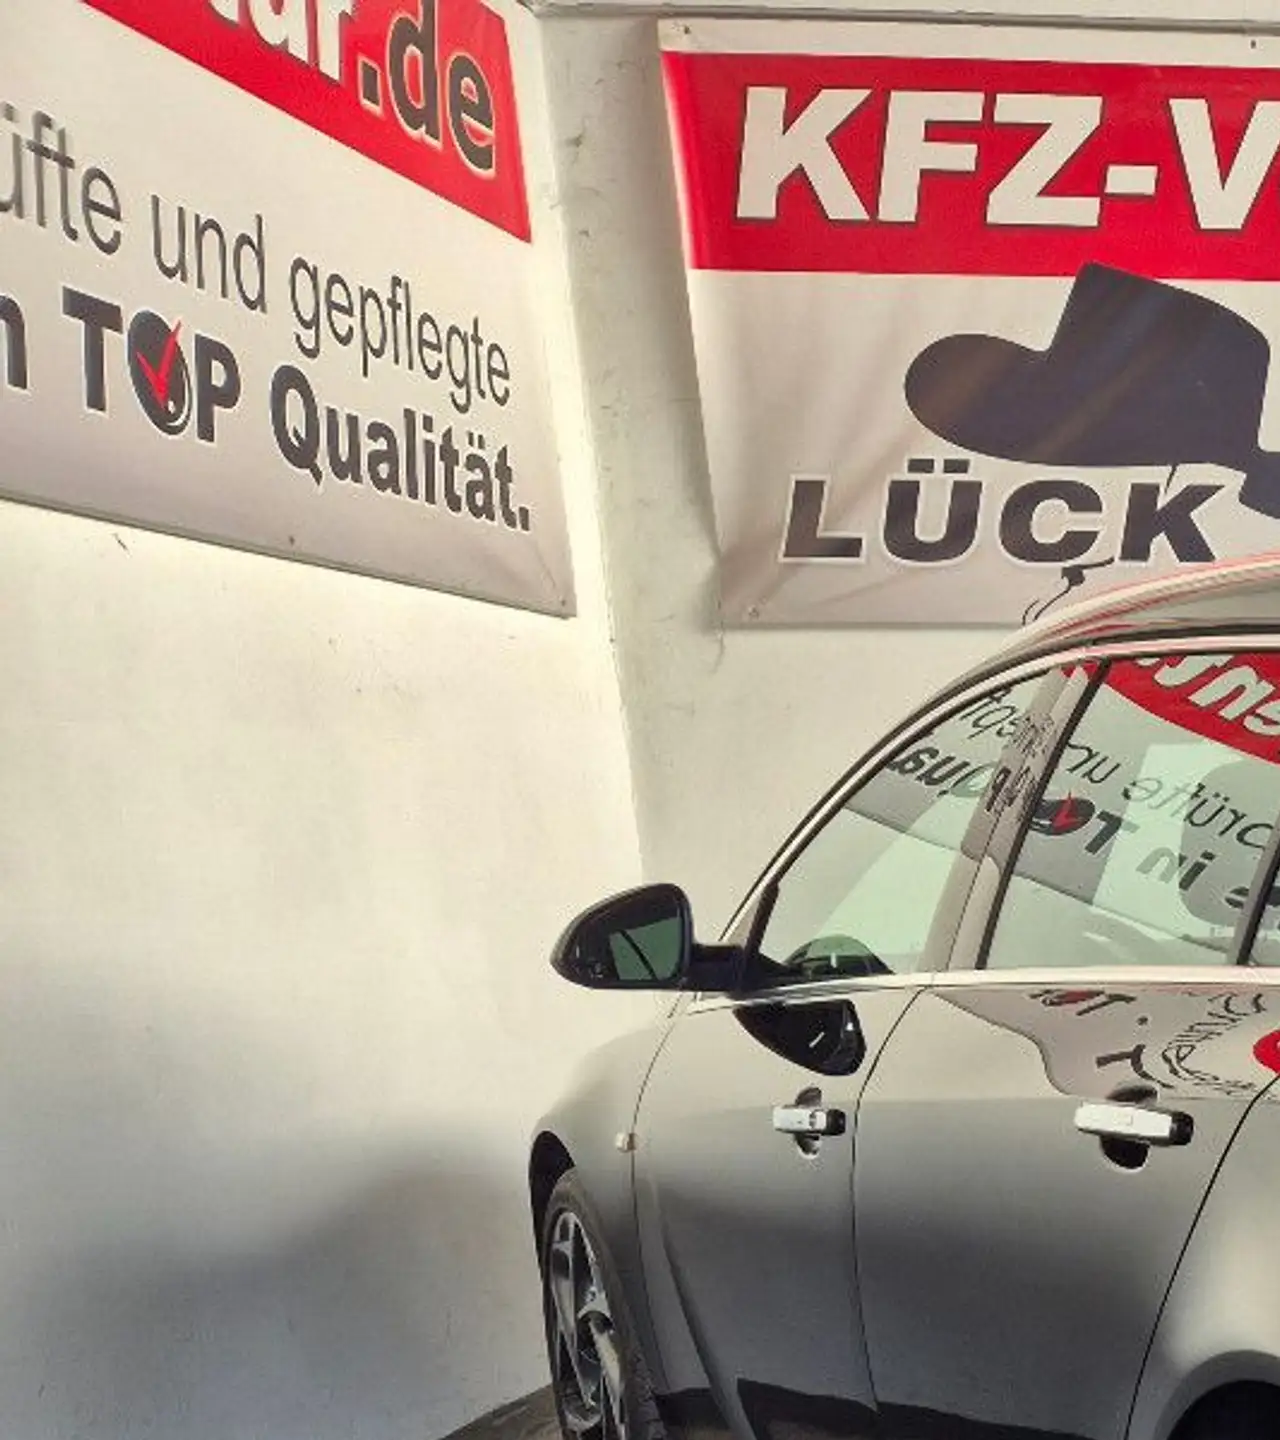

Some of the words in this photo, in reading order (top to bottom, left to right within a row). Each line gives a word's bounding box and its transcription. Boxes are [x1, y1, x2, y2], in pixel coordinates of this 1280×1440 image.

[62, 285, 240, 443] TOP
[271, 365, 530, 531] Qualität.
[151, 195, 266, 313] und
[290, 257, 510, 413] gepflegte
[782, 458, 1228, 564] LÜCK
